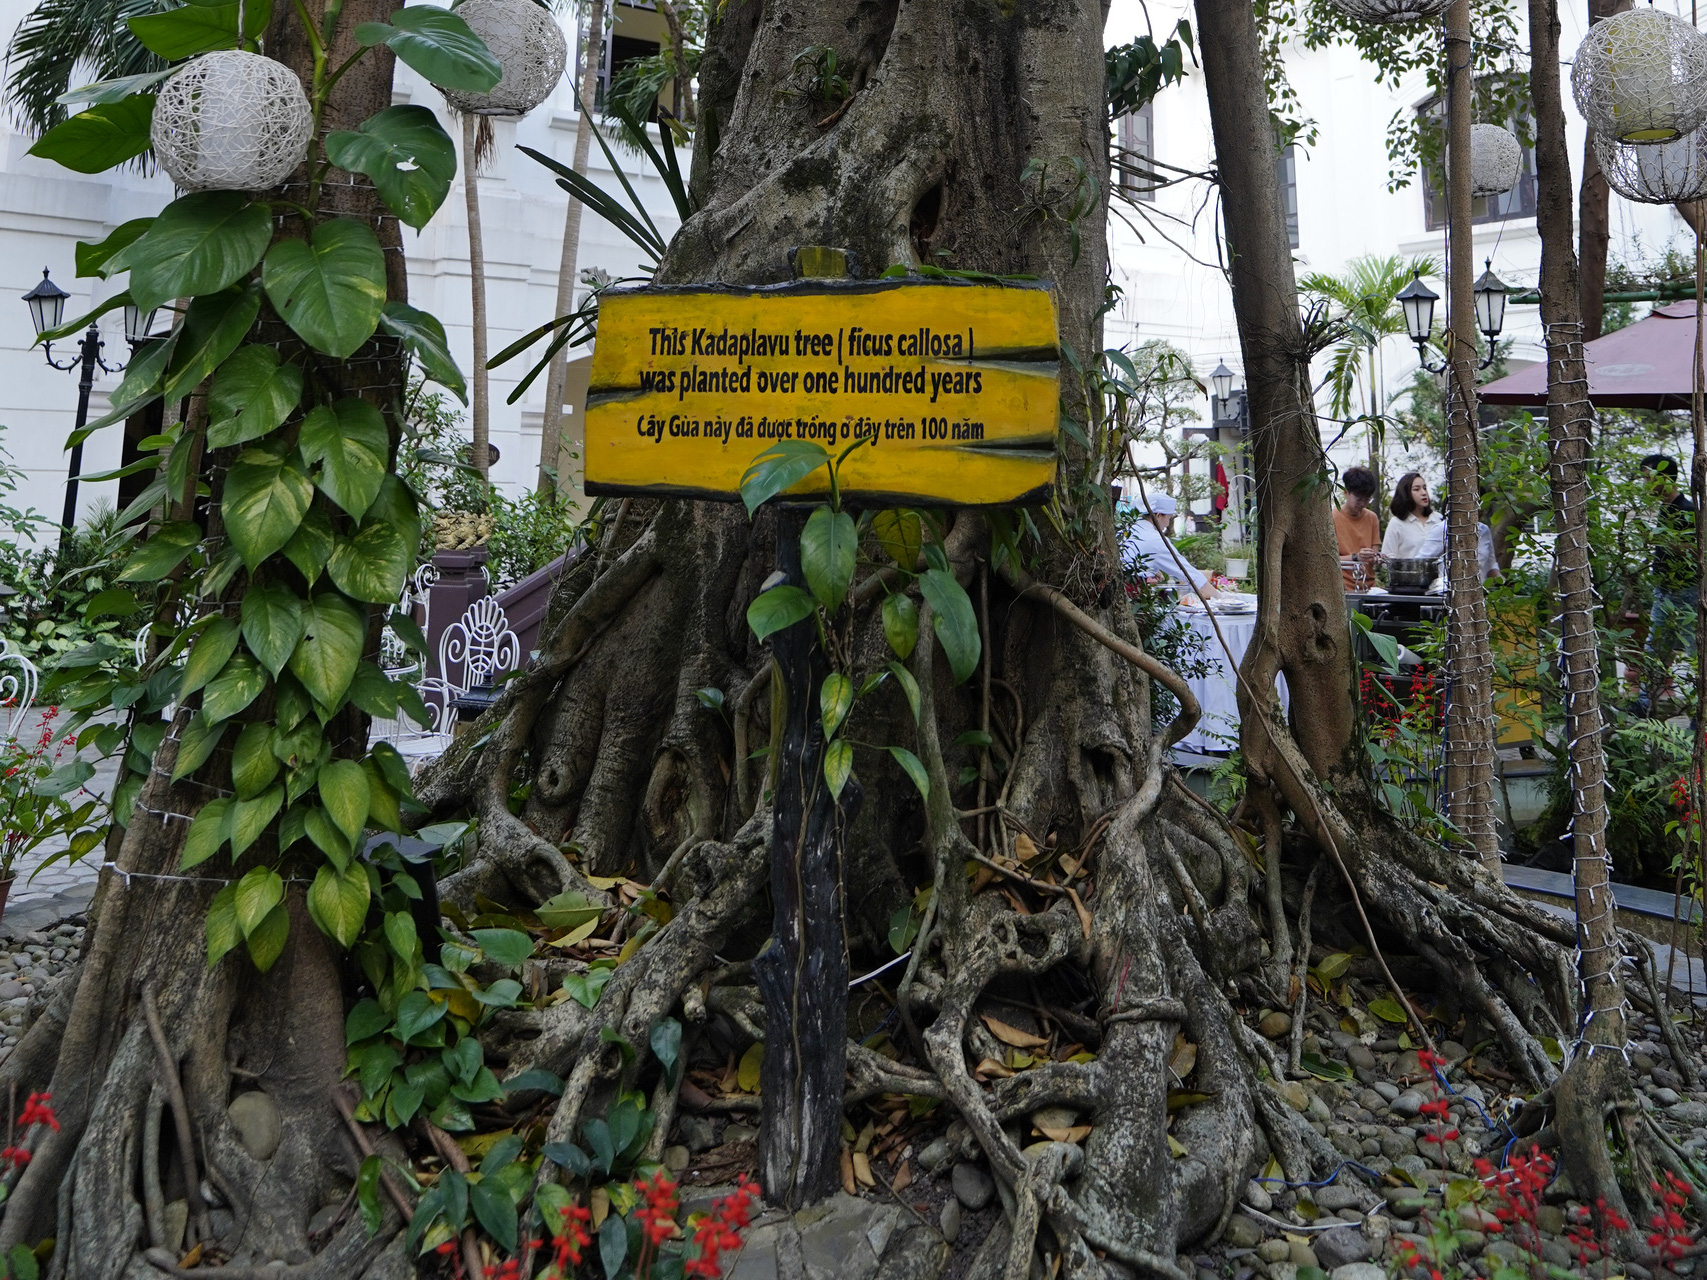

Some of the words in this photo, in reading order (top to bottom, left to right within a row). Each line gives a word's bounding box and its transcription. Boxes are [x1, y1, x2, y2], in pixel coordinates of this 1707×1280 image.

[649, 328, 686, 356] This
[691, 328, 790, 365] Kadaplavu
[794, 329, 833, 356] tree
[848, 327, 893, 356] ficus
[897, 328, 963, 356] callosa
[640, 370, 676, 393] was
[679, 365, 751, 401] planted
[757, 371, 798, 393] over
[803, 371, 839, 394] one
[844, 365, 926, 394] hundred
[930, 371, 983, 403] years
[637, 415, 666, 444] Cây
[703, 415, 732, 445] này
[735, 416, 753, 438] đã
[757, 416, 792, 442] được
[796, 415, 837, 446] trồng
[854, 416, 881, 446] đây
[885, 417, 915, 439] trên
[921, 417, 948, 440] 100
[951, 417, 984, 440] năm
